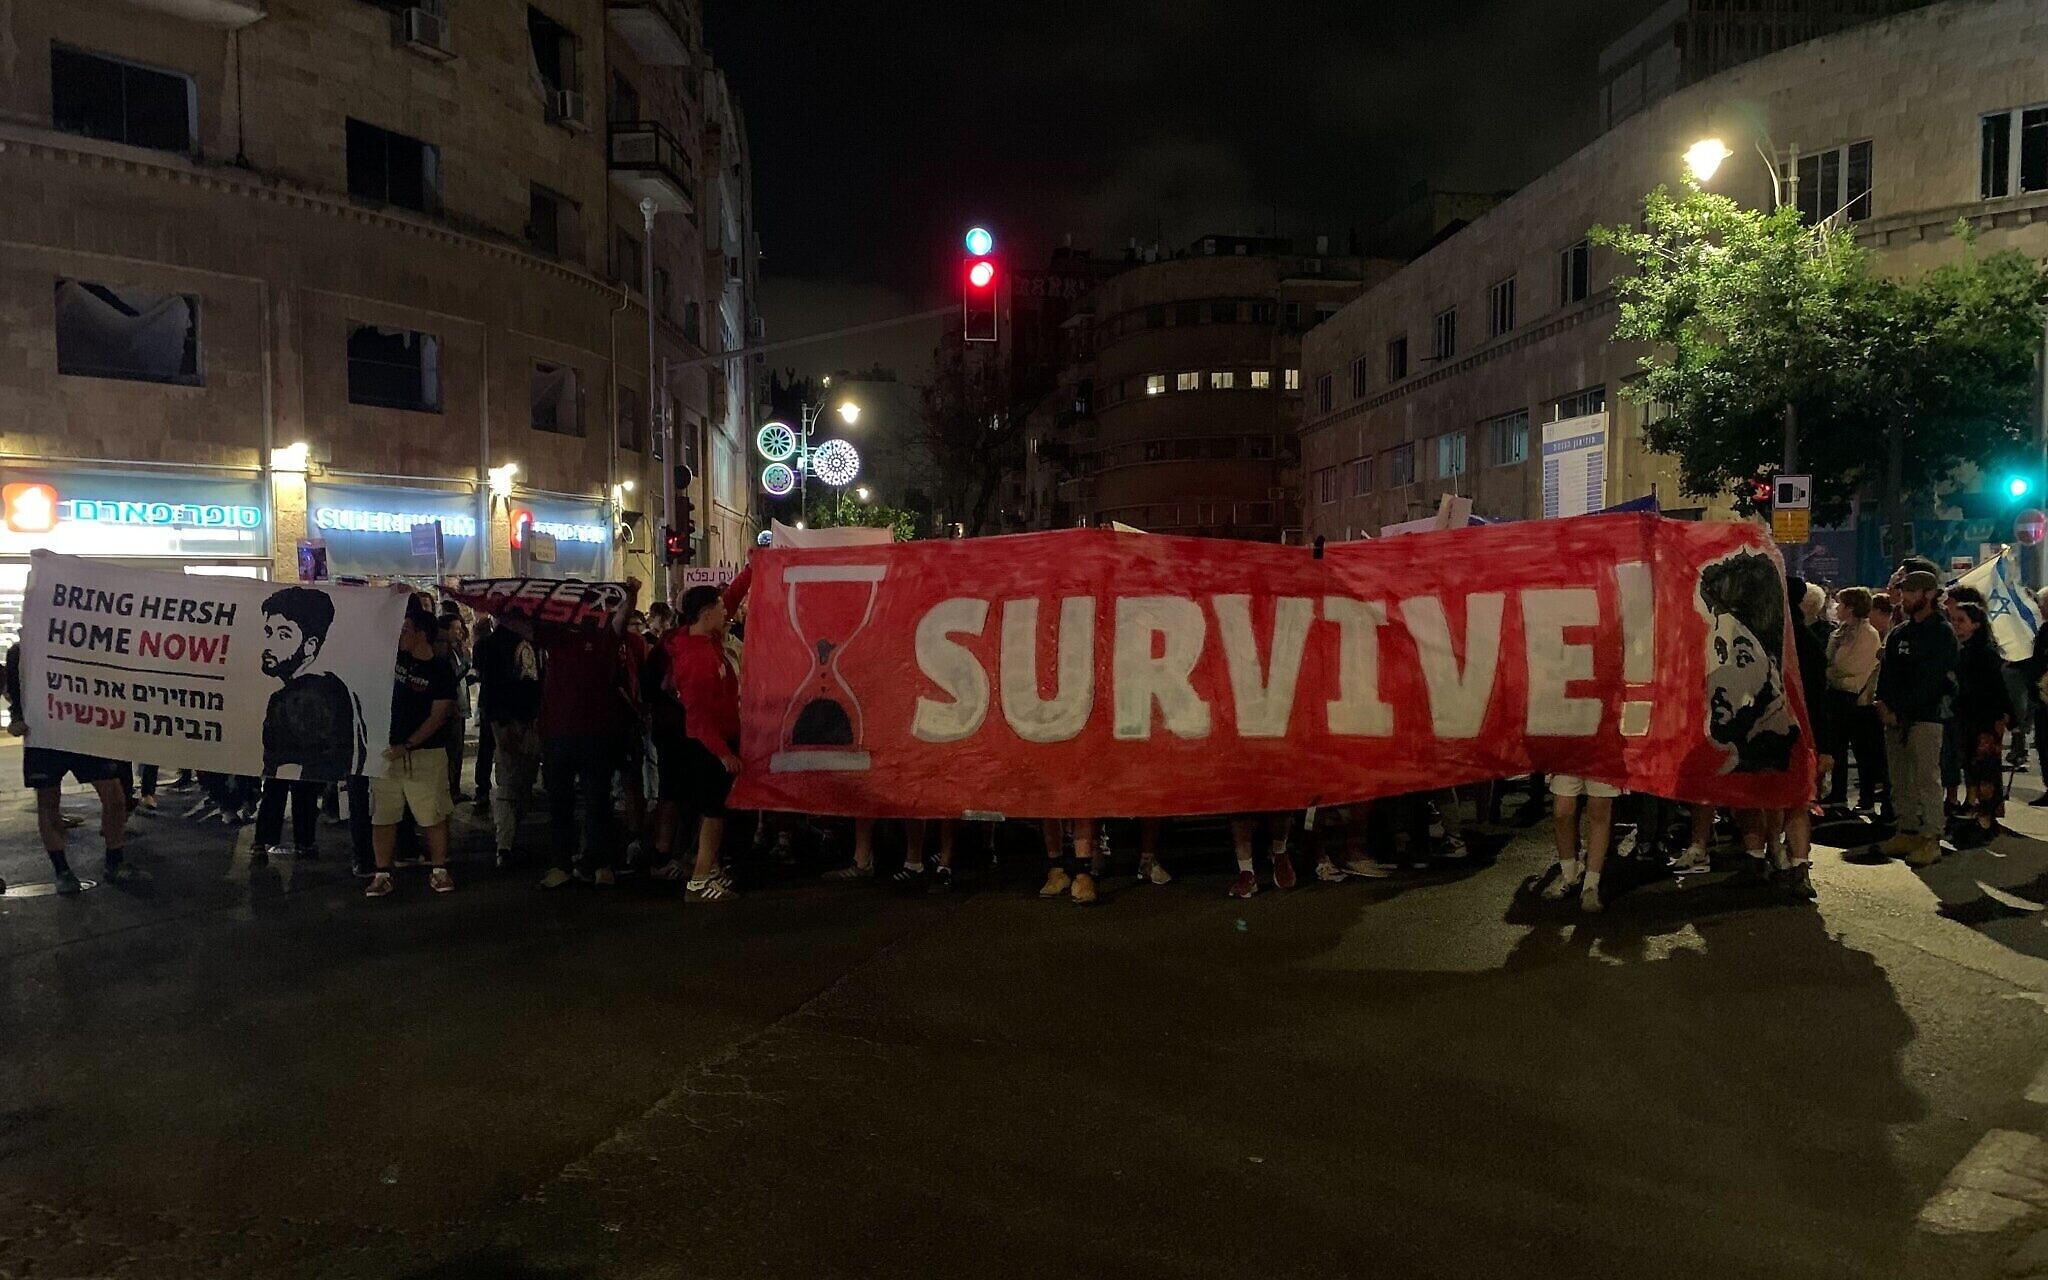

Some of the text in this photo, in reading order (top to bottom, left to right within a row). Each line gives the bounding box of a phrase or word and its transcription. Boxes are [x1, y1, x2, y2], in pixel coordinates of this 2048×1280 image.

[462, 580, 589, 603] FREE
[686, 568, 715, 582] נפלא
[53, 583, 237, 626] BRING HERSH
[48, 617, 230, 665] HOME NOW!
[912, 561, 1656, 744] SURVIVE!
[46, 671, 224, 711] מחזירים את הרש
[47, 692, 223, 742] הביתה עכשיו!
